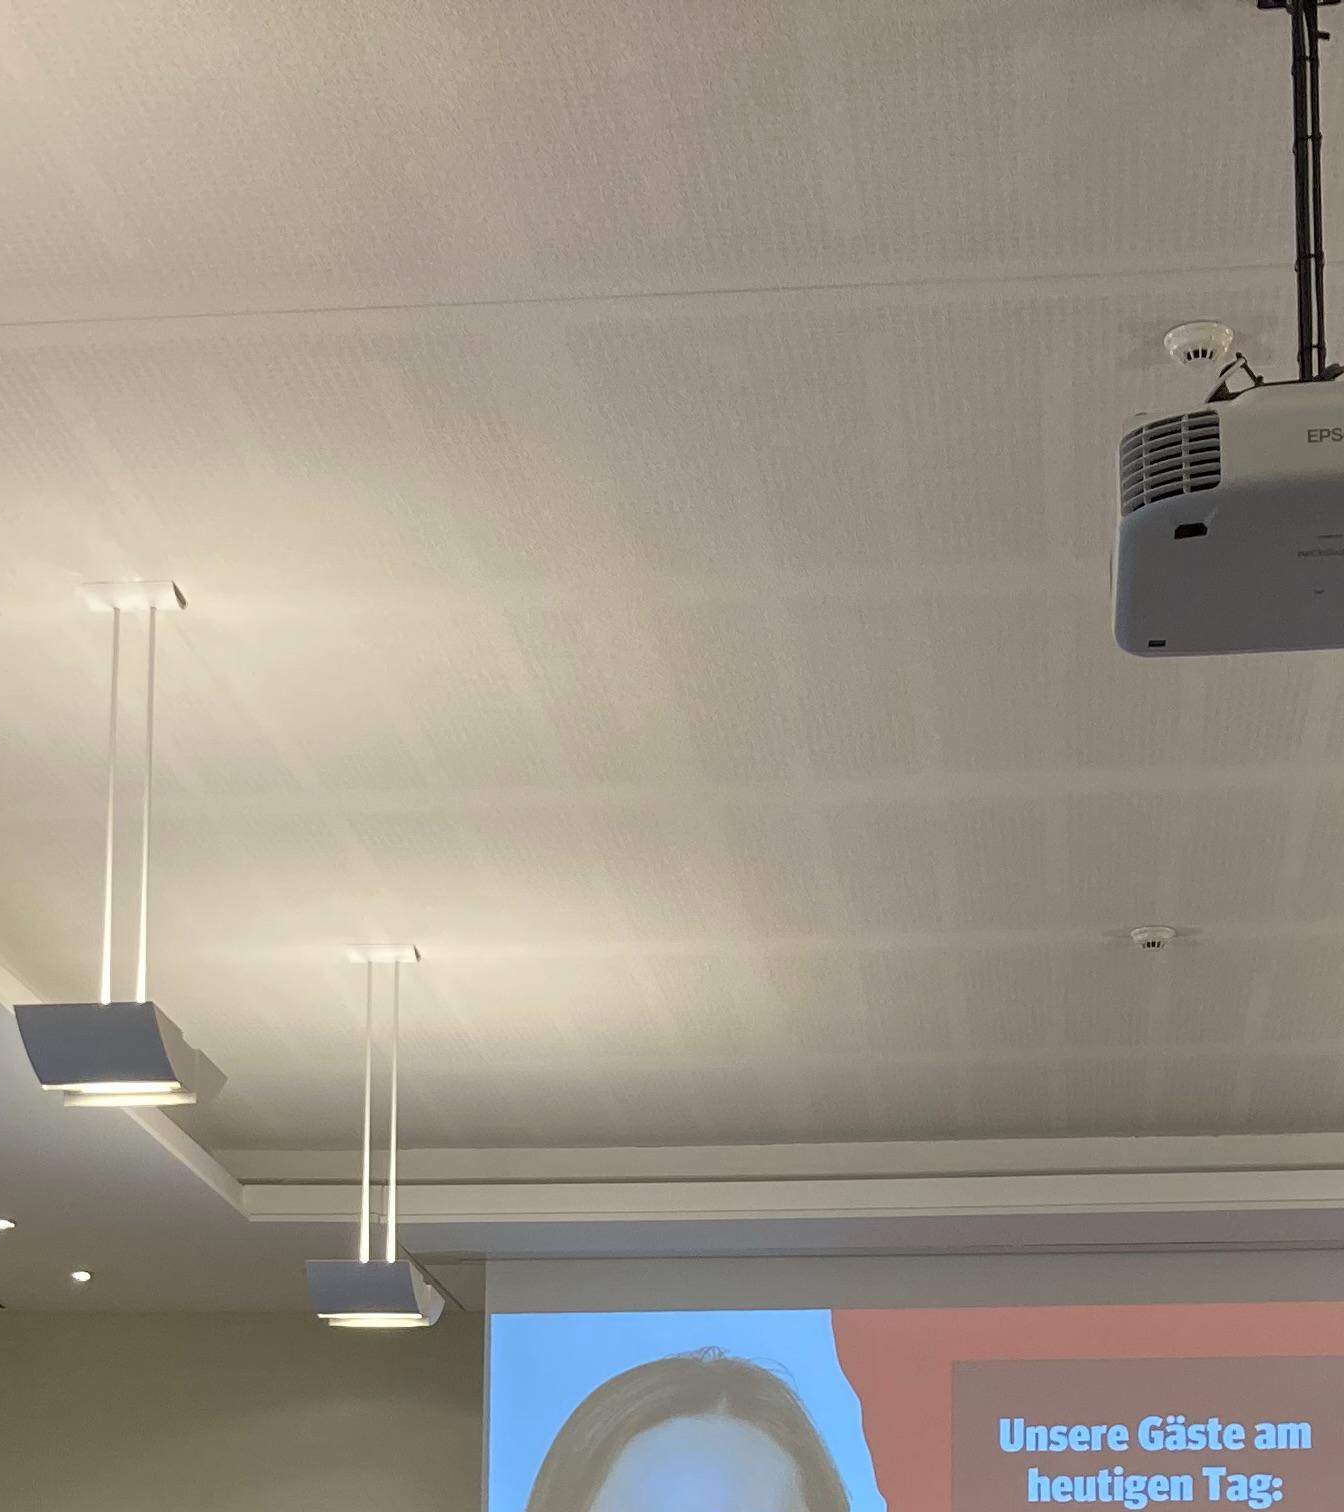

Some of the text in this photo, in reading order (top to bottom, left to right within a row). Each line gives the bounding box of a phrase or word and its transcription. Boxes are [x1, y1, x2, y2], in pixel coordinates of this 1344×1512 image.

[998, 1414, 1313, 1452] Unsere Gäste am
[1026, 1465, 1284, 1511] heutigen Tag:
